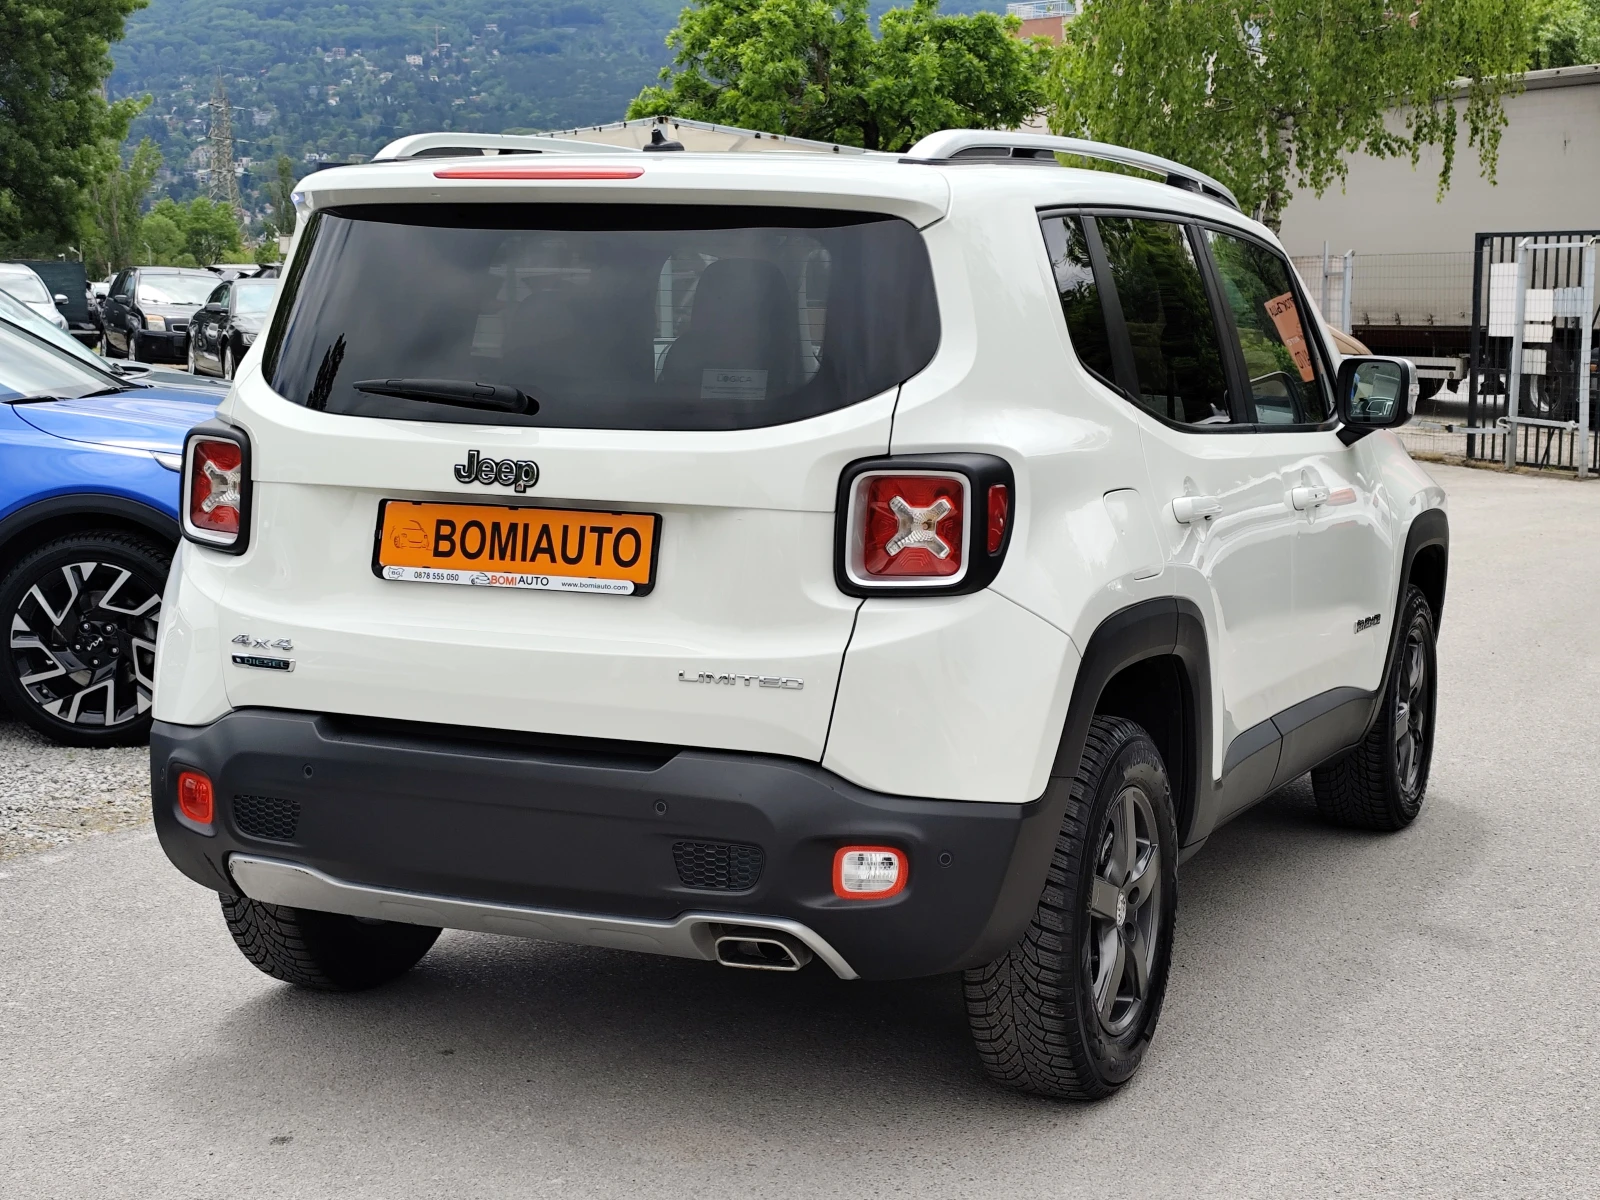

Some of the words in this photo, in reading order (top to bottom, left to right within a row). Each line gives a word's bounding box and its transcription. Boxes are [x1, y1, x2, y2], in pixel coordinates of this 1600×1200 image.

[454, 449, 540, 493] Jeep
[432, 519, 642, 568] BOMIAUTO
[413, 571, 431, 579] 0878
[432, 572, 445, 580] 555
[446, 573, 460, 581] 050
[561, 582, 628, 591] www.bomiauto.com
[244, 657, 289, 668] DIESEL
[678, 670, 804, 690] LIMITED
